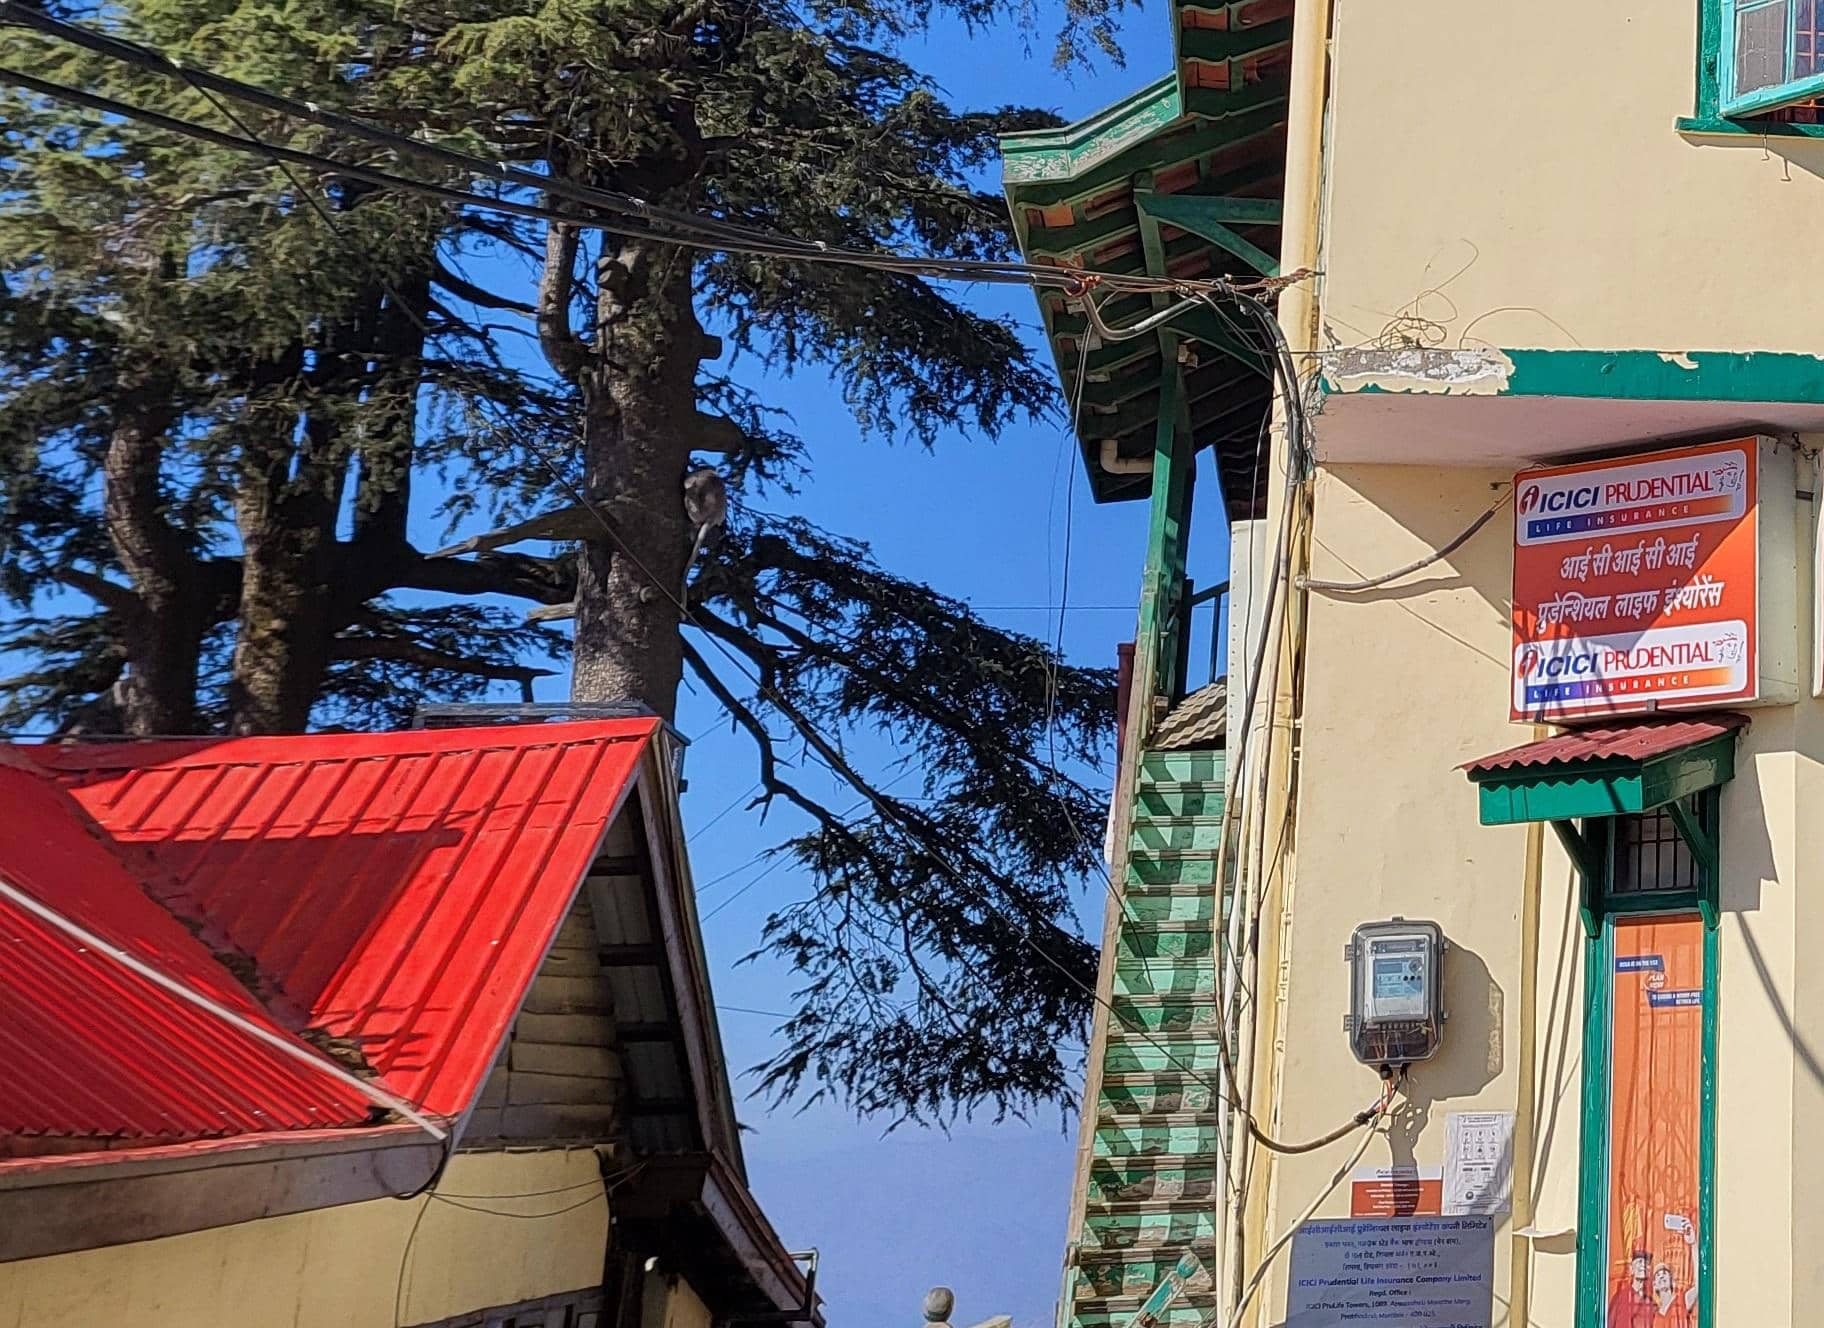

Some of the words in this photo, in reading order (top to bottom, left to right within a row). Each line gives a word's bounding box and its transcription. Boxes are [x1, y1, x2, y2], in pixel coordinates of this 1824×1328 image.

[1539, 487, 1600, 513] ICICI
[1605, 471, 1714, 505] PRUDENTIAL
[1535, 521, 1572, 533] LIFE
[1587, 505, 1690, 527] INSURANCE
[1561, 547, 1593, 582] आई
[1592, 543, 1612, 576] सी
[1612, 540, 1645, 576] आई
[1645, 537, 1665, 569] सी
[1666, 533, 1699, 568] आई
[1614, 588, 1660, 619] लाइफ
[1538, 652, 1598, 678] ICICI
[1604, 641, 1714, 672] PRUDENTIAL
[1533, 687, 1570, 699] LIFE
[1586, 675, 1690, 694] INSURANCE
[1298, 1279, 1317, 1287] ICICI
[1319, 1278, 1358, 1286] Prudential
[1361, 1277, 1374, 1285] Life
[1377, 1276, 1413, 1285] Insurance
[1416, 1275, 1451, 1284] Company
[1454, 1274, 1481, 1282] Limited
